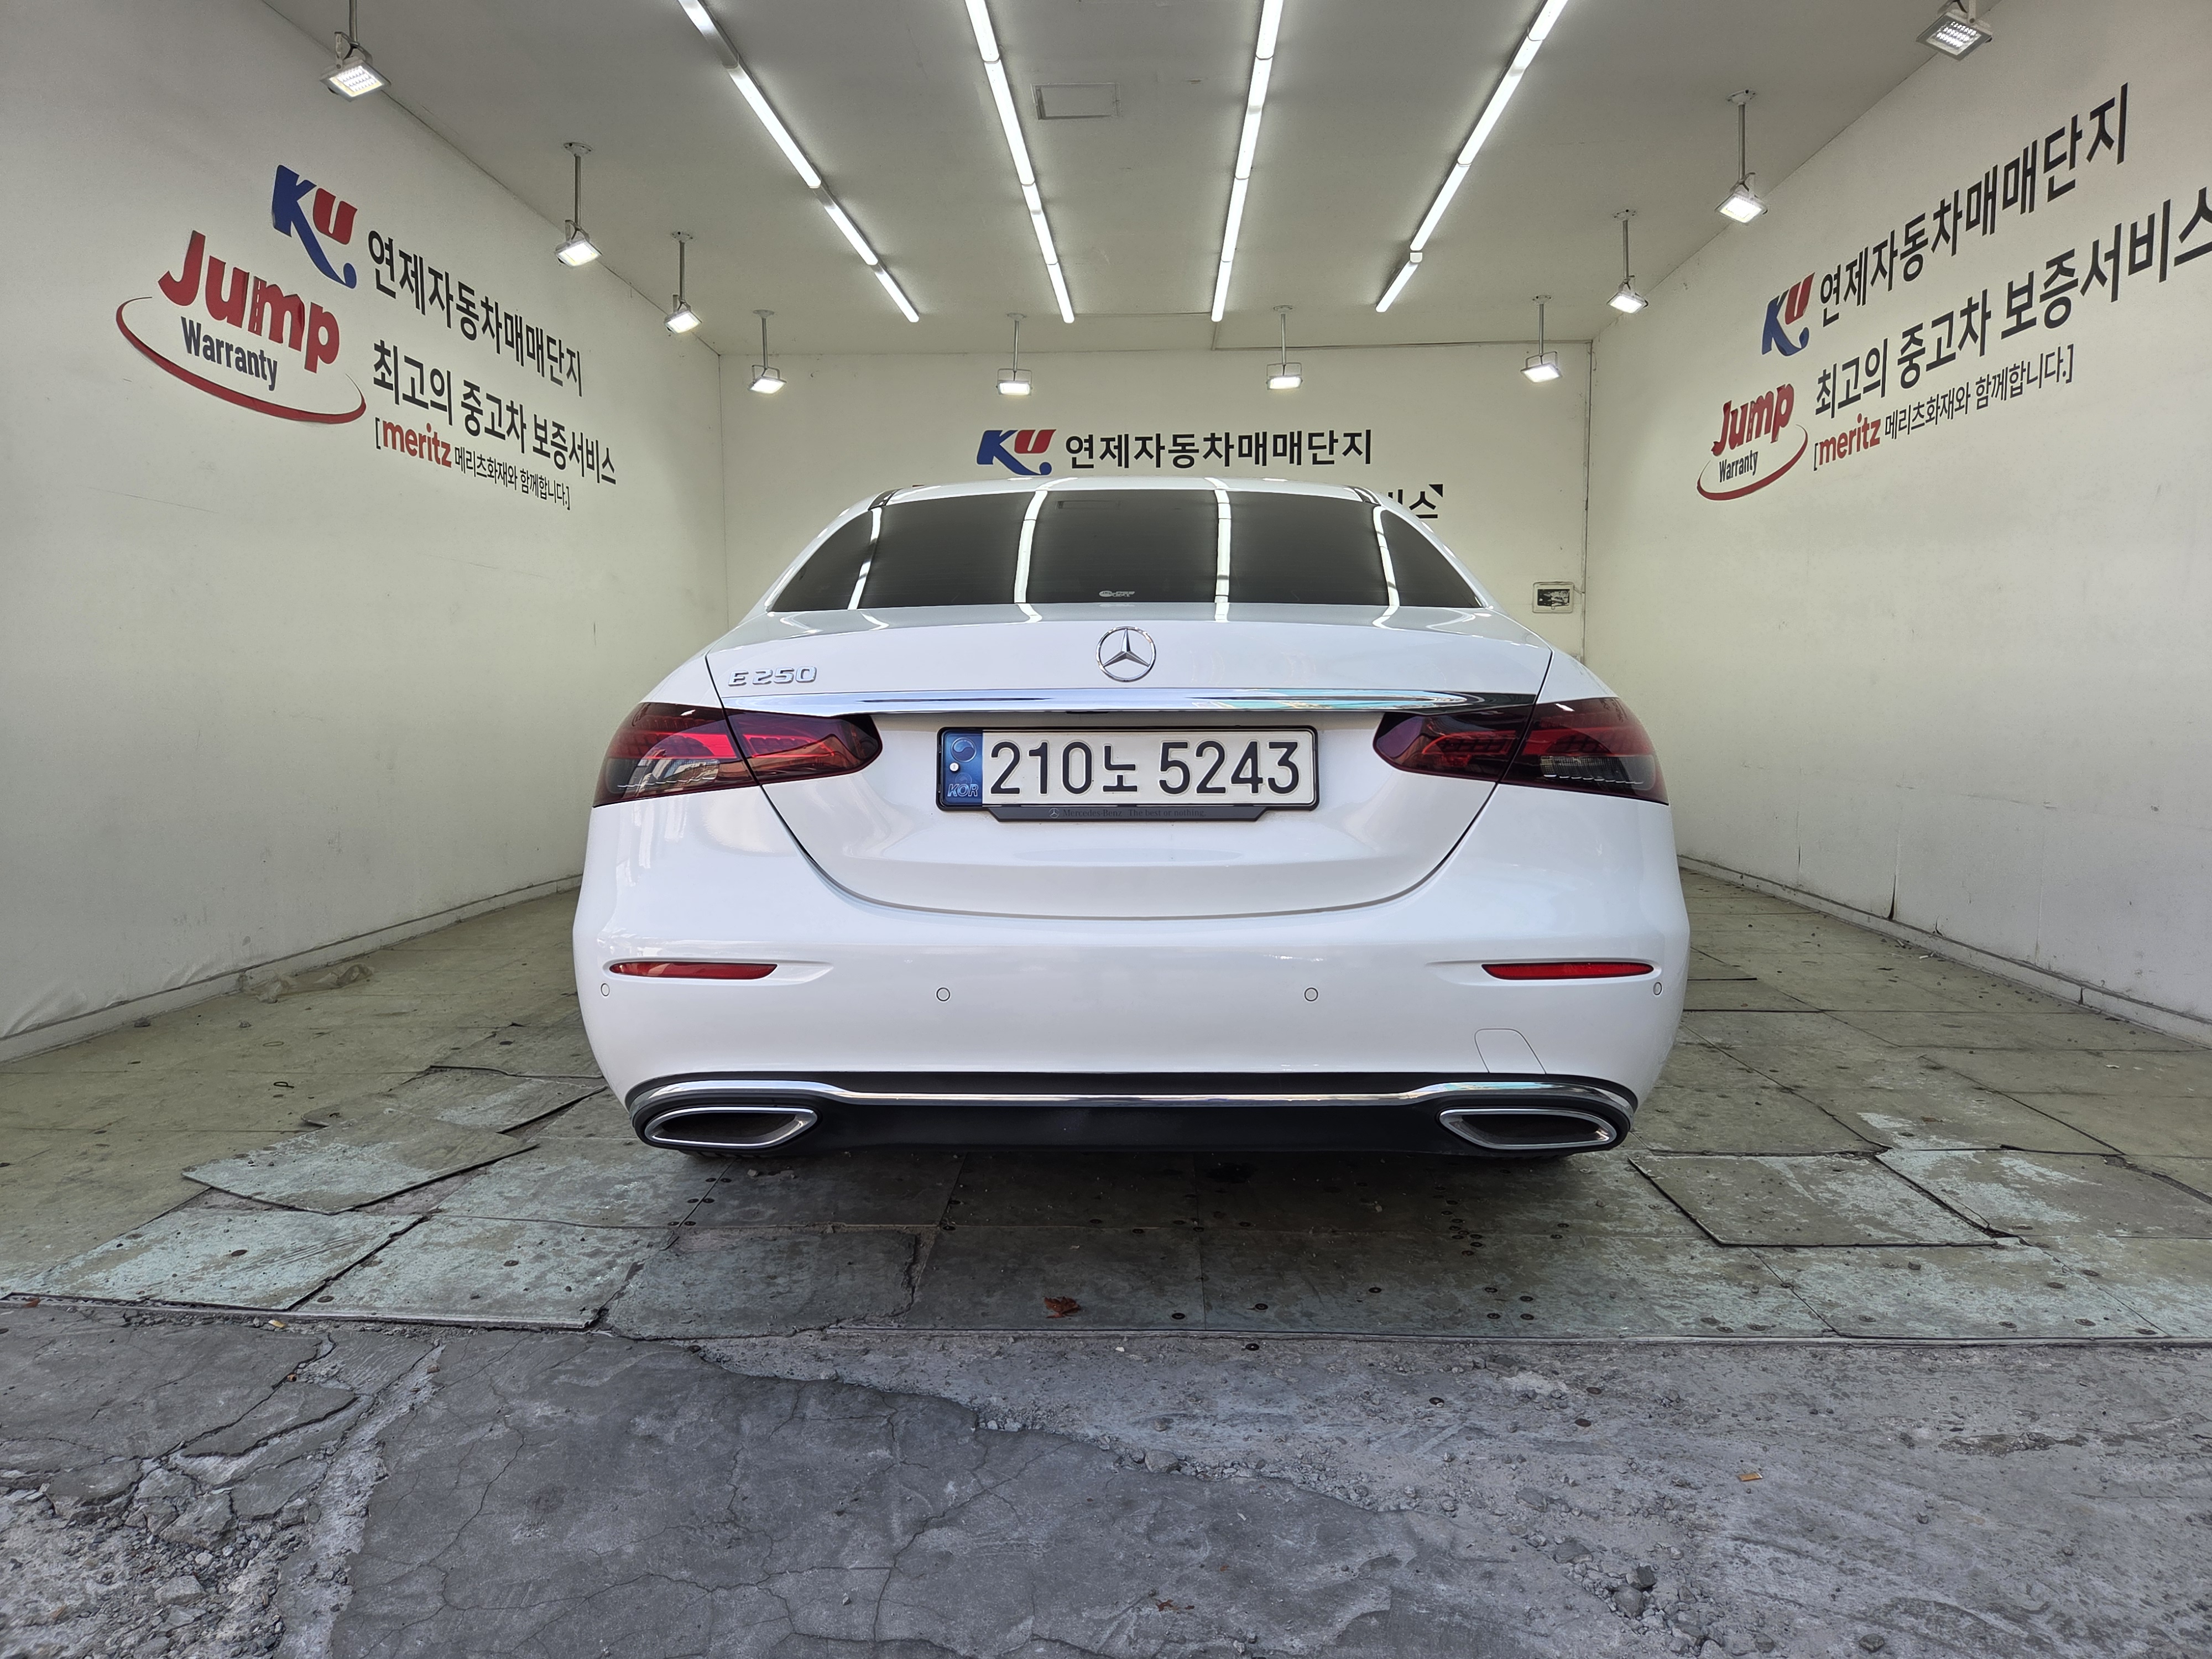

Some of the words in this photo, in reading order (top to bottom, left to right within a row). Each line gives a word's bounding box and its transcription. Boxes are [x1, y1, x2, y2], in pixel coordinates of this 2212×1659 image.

[1820, 82, 2128, 327] 연제자동차매매단지
[158, 230, 340, 373] Jump
[368, 230, 582, 397] 연제자동차매매단지
[1815, 338, 1888, 419] 최고의
[1897, 289, 1991, 389] 중고차
[2001, 187, 2212, 340] 보증서비스
[181, 316, 277, 392] Warranty
[373, 340, 453, 426] 최고의
[461, 379, 526, 453] 중고차
[533, 414, 616, 485] 보증서비스
[1711, 383, 1794, 456] Jump
[1813, 413, 1881, 471] [meritz
[1885, 382, 1971, 440] 메리츠화재와
[1975, 344, 2074, 410] 함께합니다.]
[375, 417, 452, 468] [meritz
[455, 446, 518, 491] 메리츠화재와
[520, 468, 571, 510] 함께합니다.]
[1065, 429, 1371, 469] 연제자동차매매단지
[1719, 450, 1759, 483] Warranty
[728, 670, 749, 687] E
[752, 666, 817, 685] 250
[947, 784, 979, 797] KOR
[990, 741, 1138, 795] 210노
[1159, 740, 1298, 795] 5243
[1174, 809, 1207, 817] nothing.
